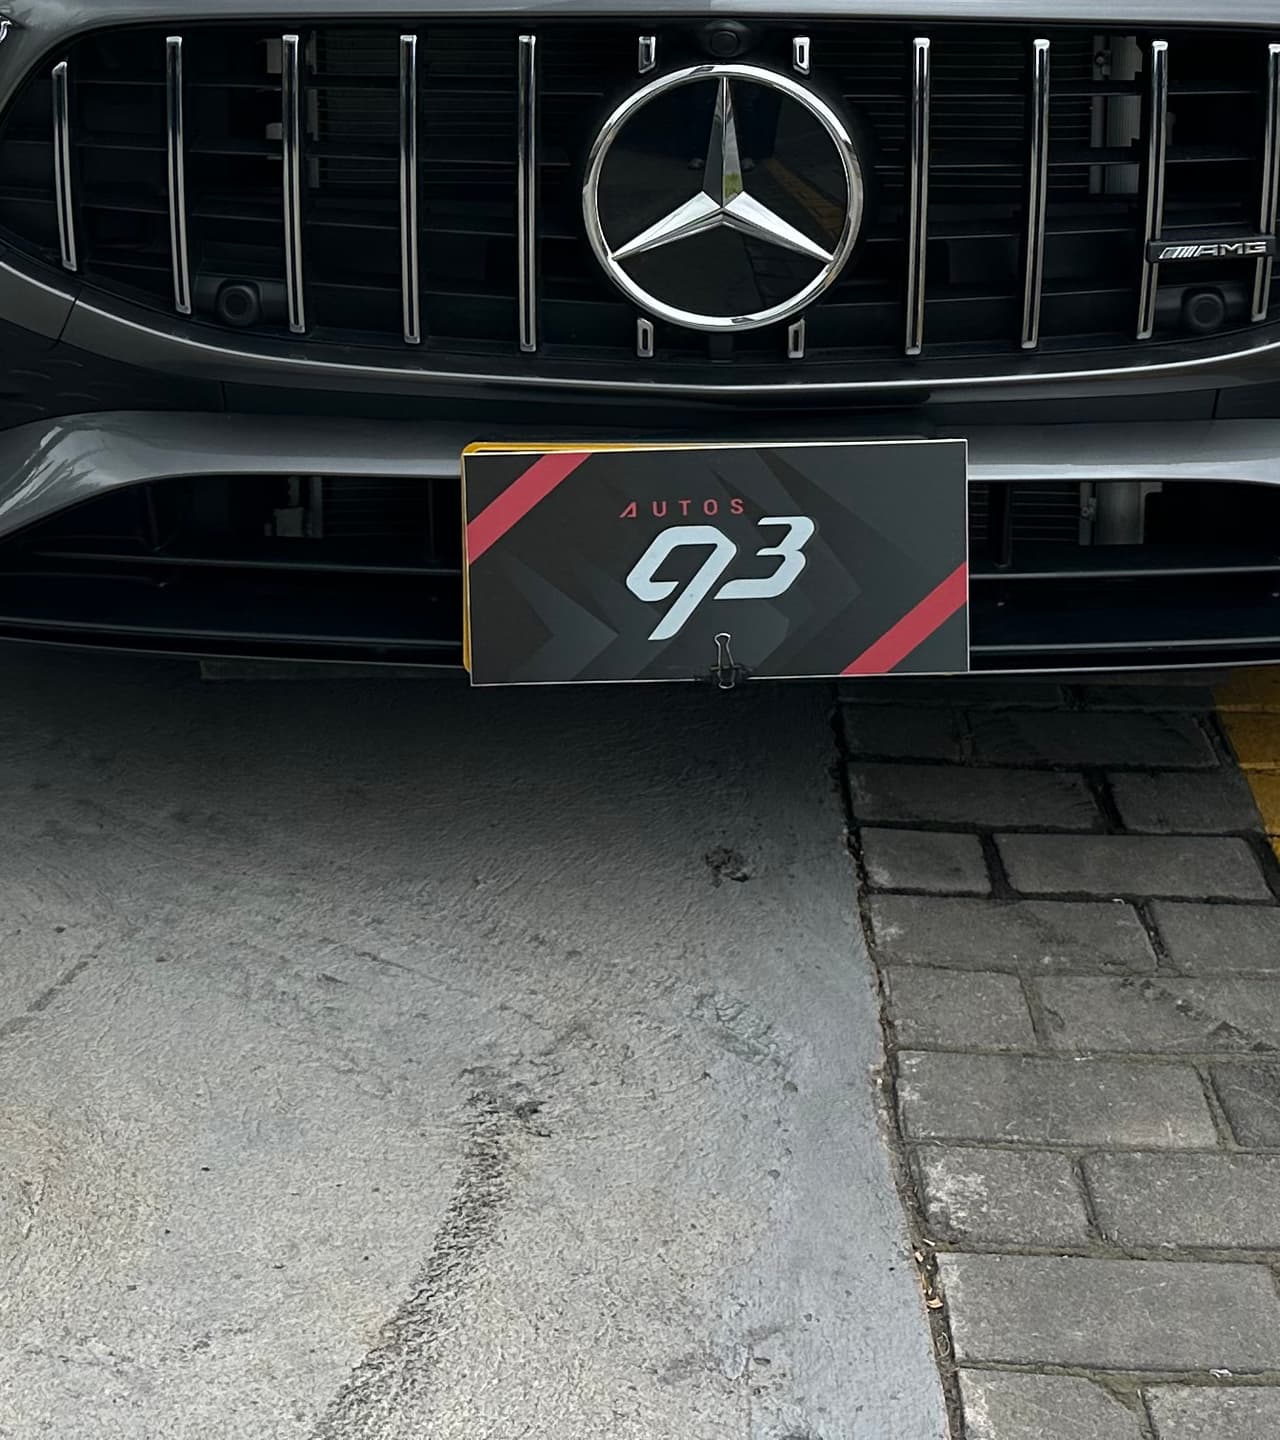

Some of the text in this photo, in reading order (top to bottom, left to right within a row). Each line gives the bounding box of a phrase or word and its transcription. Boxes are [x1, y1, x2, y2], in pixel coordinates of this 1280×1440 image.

[1194, 241, 1267, 257] AMG
[620, 498, 744, 518] AUTOS
[626, 516, 815, 641] 93
